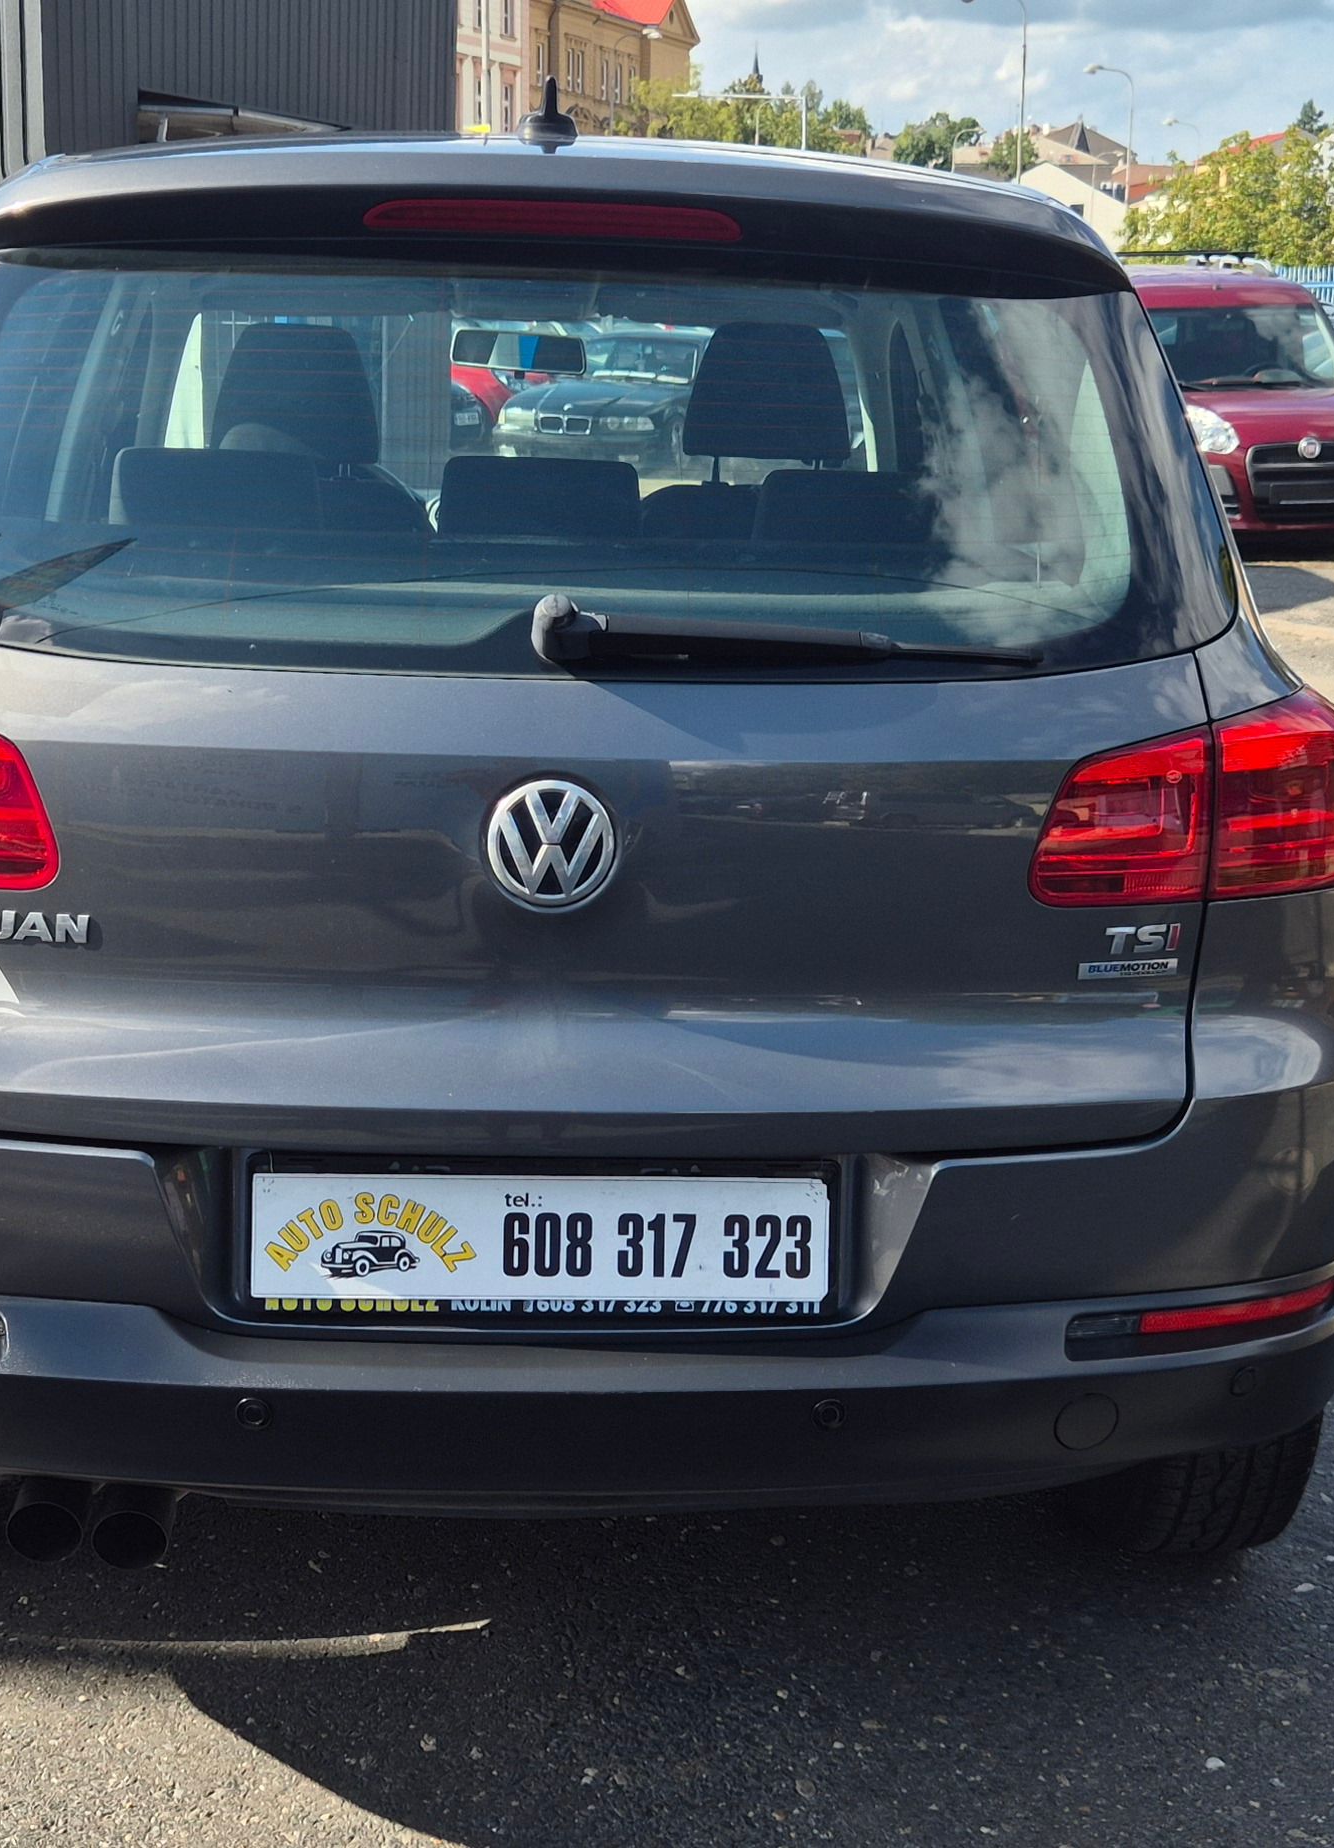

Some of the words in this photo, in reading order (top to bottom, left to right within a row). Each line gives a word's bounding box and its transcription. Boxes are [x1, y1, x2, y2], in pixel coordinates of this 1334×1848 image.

[1105, 923, 1181, 954] TSI
[1088, 961, 1169, 974] BLUEMOTION
[504, 1193, 542, 1207] tel.:
[265, 1199, 344, 1272] AUTO
[354, 1192, 477, 1273] SCHULZ
[503, 1212, 593, 1277] 608
[617, 1213, 697, 1277] 317
[723, 1214, 812, 1279] 323
